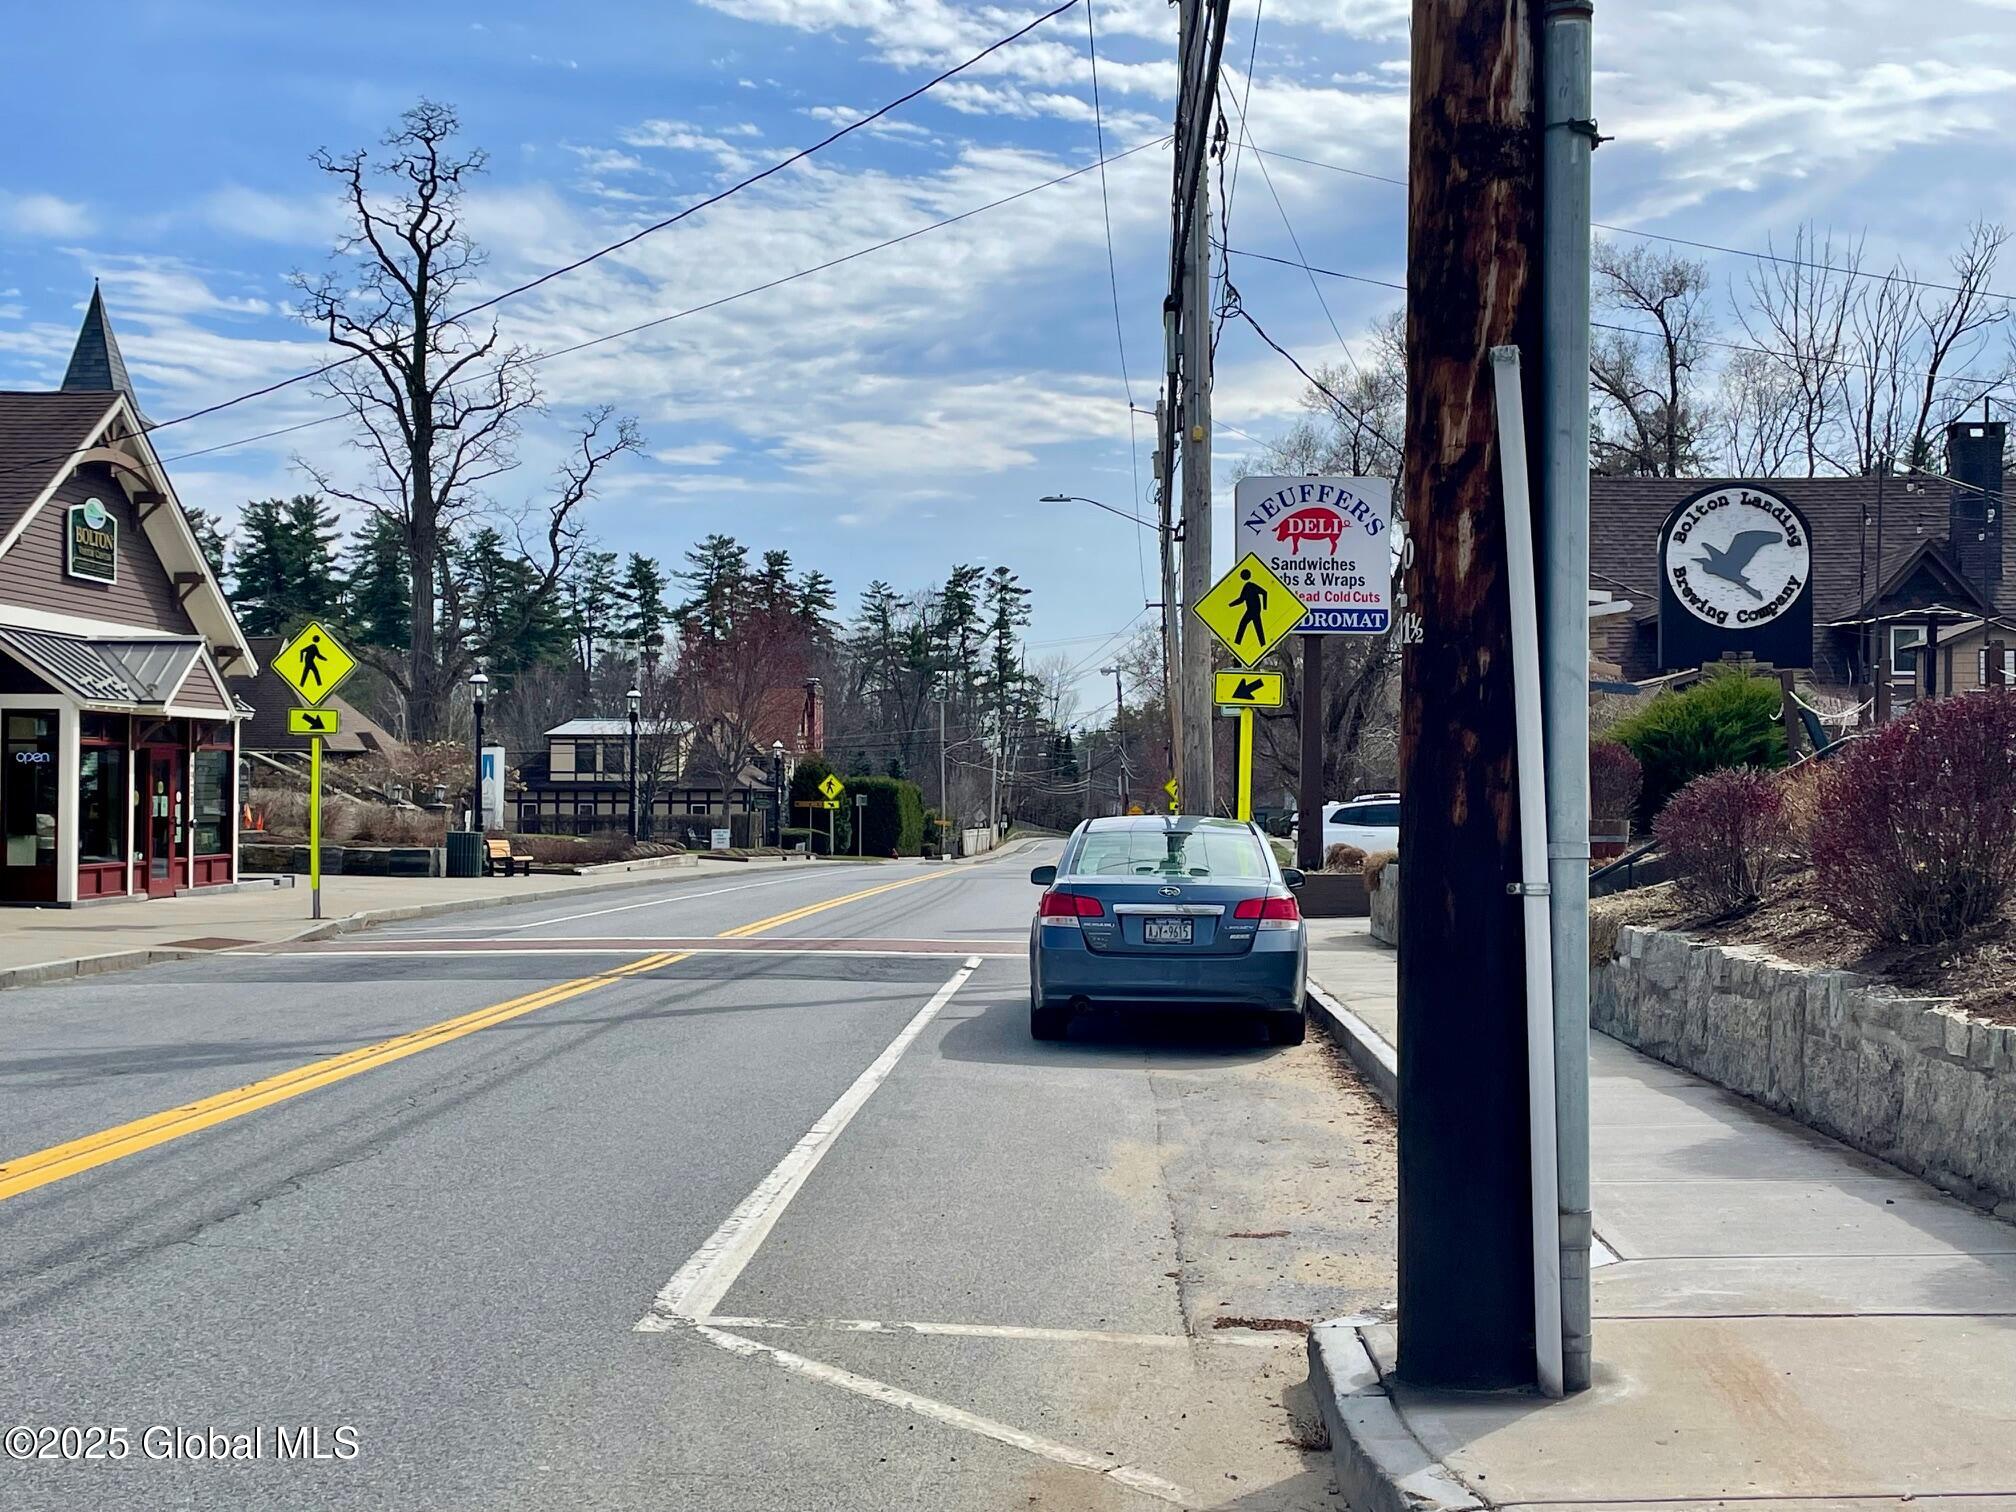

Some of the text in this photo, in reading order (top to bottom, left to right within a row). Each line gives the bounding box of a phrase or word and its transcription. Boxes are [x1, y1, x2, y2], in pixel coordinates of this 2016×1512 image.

[1243, 484, 1385, 537] NEUFFER'S
[1287, 517, 1341, 535] DELI
[1673, 492, 1802, 548] Bolton Landing
[75, 525, 114, 550] BOLTON
[1271, 556, 1356, 571] Sandwiches
[1280, 572, 1366, 590] bs & Wraps
[1295, 590, 1381, 603] ead Cold Cuts
[1673, 566, 1802, 625] Brewing Company
[1300, 612, 1385, 629] DROMAT
[15, 752, 50, 765] open
